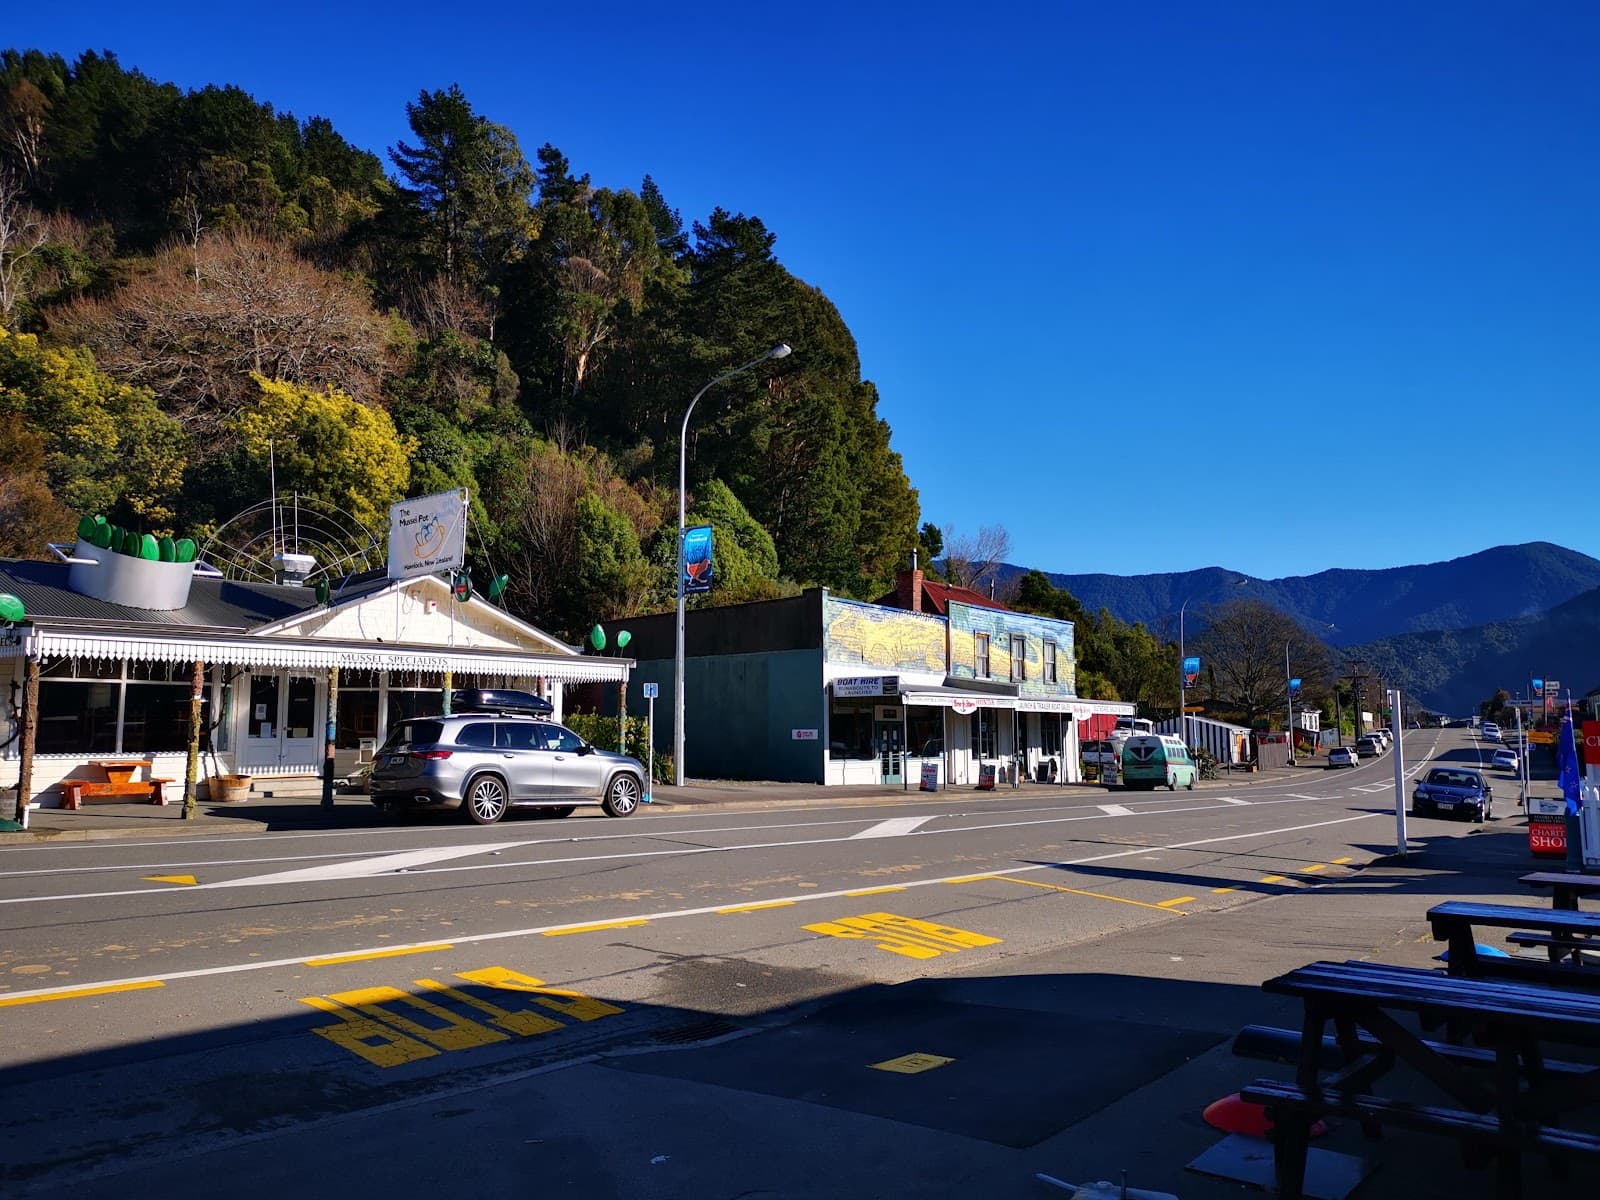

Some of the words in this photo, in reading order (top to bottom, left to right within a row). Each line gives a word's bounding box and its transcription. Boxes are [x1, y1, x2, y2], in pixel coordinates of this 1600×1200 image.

[400, 509, 411, 518] The
[418, 514, 429, 522] Pot
[340, 653, 382, 663] MUSSEL
[387, 655, 449, 666] SPECIALISTS
[837, 678, 858, 686] BOAT
[860, 677, 880, 685] HIRE
[1531, 829, 1565, 837] CHARIT
[800, 912, 1005, 960] BUS
[297, 966, 626, 1068] STOP
